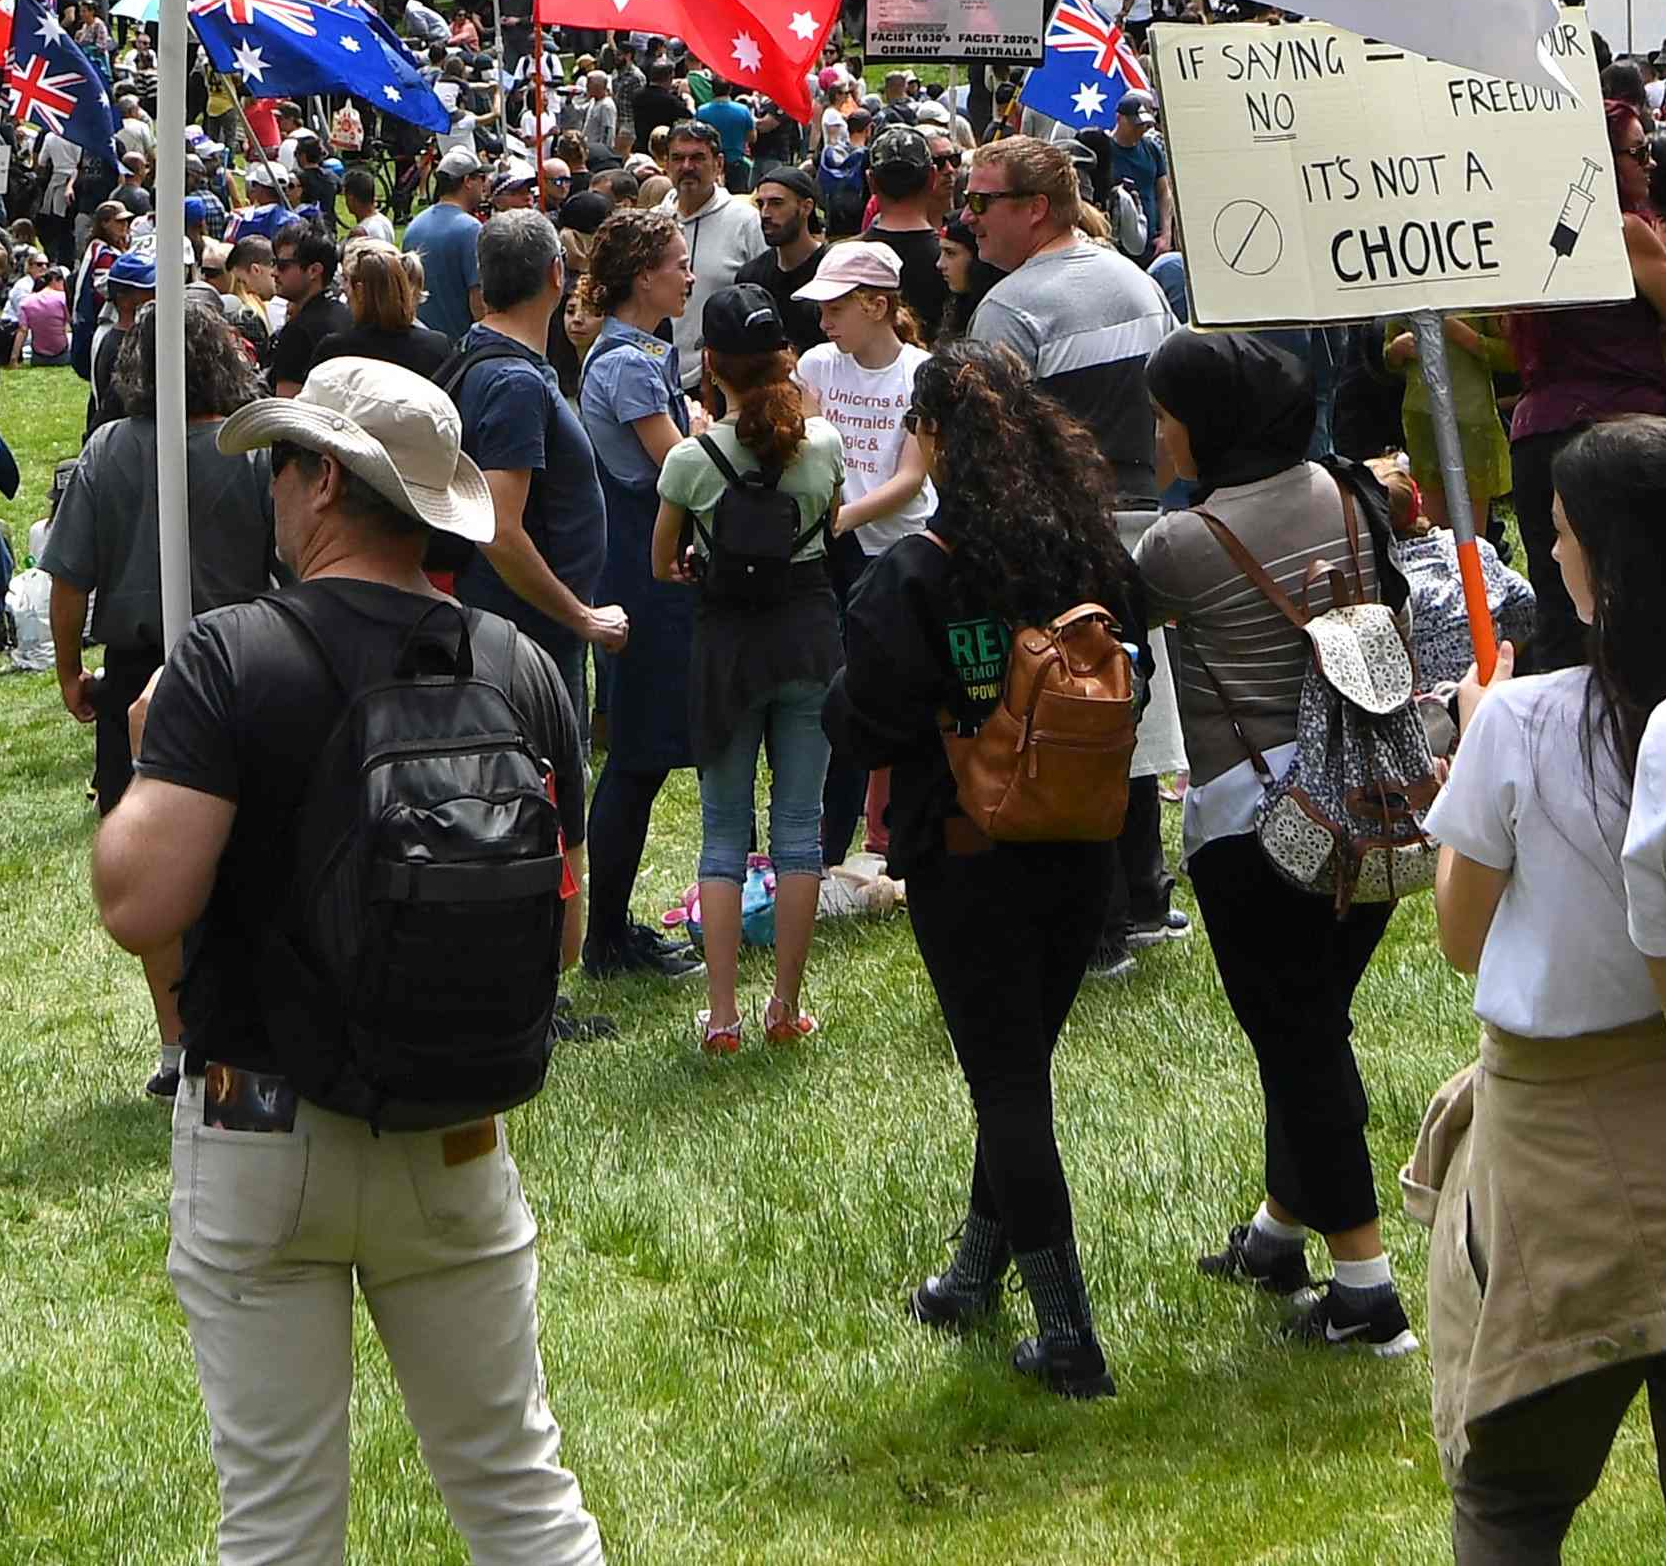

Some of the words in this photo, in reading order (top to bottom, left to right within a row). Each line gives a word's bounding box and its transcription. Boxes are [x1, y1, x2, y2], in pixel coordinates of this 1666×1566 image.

[871, 33, 914, 43] FACIST
[917, 33, 951, 43] 1930's
[958, 34, 1000, 44] FACIST
[1003, 34, 1039, 45] 2020's
[881, 45, 941, 55] GERMANY
[964, 47, 1032, 57] AUSTRALIA
[1177, 45, 1205, 80] IF
[1221, 35, 1346, 82] SAYING
[1245, 92, 1295, 132] NO
[1302, 156, 1360, 203] IT'S
[1371, 154, 1446, 198] NOT
[1466, 150, 1493, 192] A
[1332, 219, 1500, 283] CHOICE
[827, 387, 890, 409] Unicorns
[825, 408, 895, 430] Mermaids
